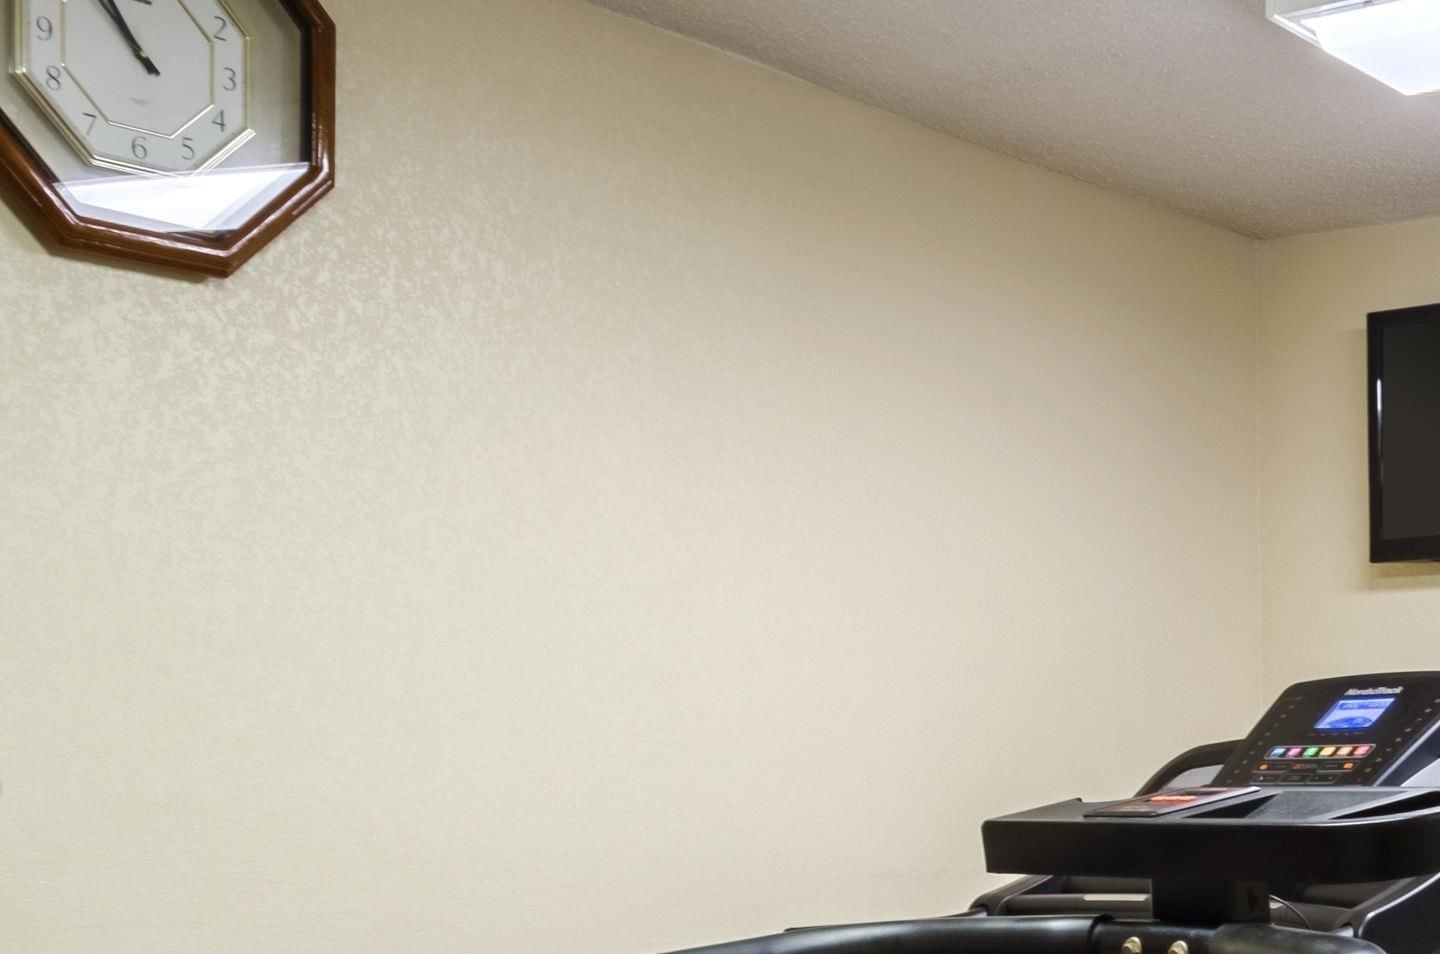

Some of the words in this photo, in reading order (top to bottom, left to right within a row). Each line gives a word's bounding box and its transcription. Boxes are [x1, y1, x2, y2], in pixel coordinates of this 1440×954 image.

[36, 16, 53, 40] 9
[213, 16, 228, 41] 2
[45, 65, 61, 91] 8
[223, 67, 236, 91] 3
[82, 112, 97, 136] 7
[211, 110, 225, 132] 4
[131, 136, 148, 160] 6
[181, 138, 195, 160] 5
